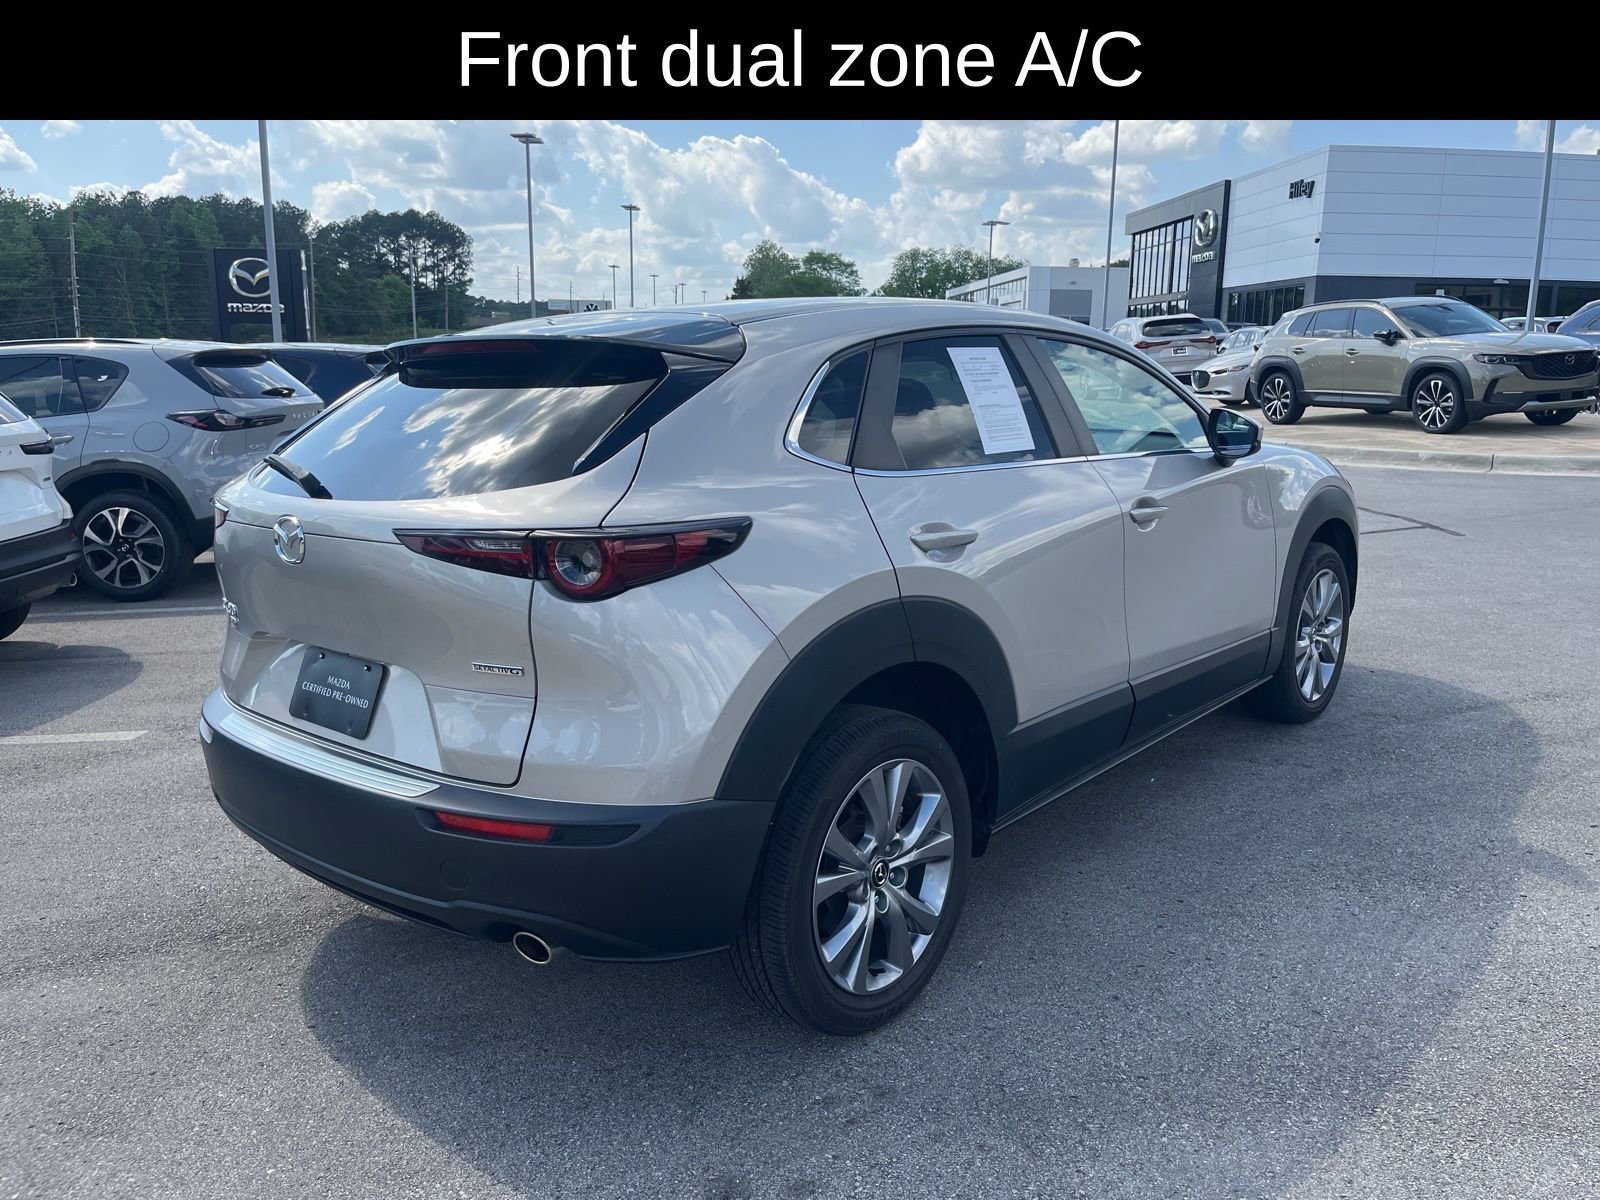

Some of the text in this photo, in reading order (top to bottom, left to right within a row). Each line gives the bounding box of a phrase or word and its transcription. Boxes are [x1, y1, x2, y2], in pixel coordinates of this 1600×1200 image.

[1288, 179, 1315, 199] Hiley
[326, 675, 350, 690] MAZDA
[301, 681, 369, 708] CERTIFIED PRE-OWNED
